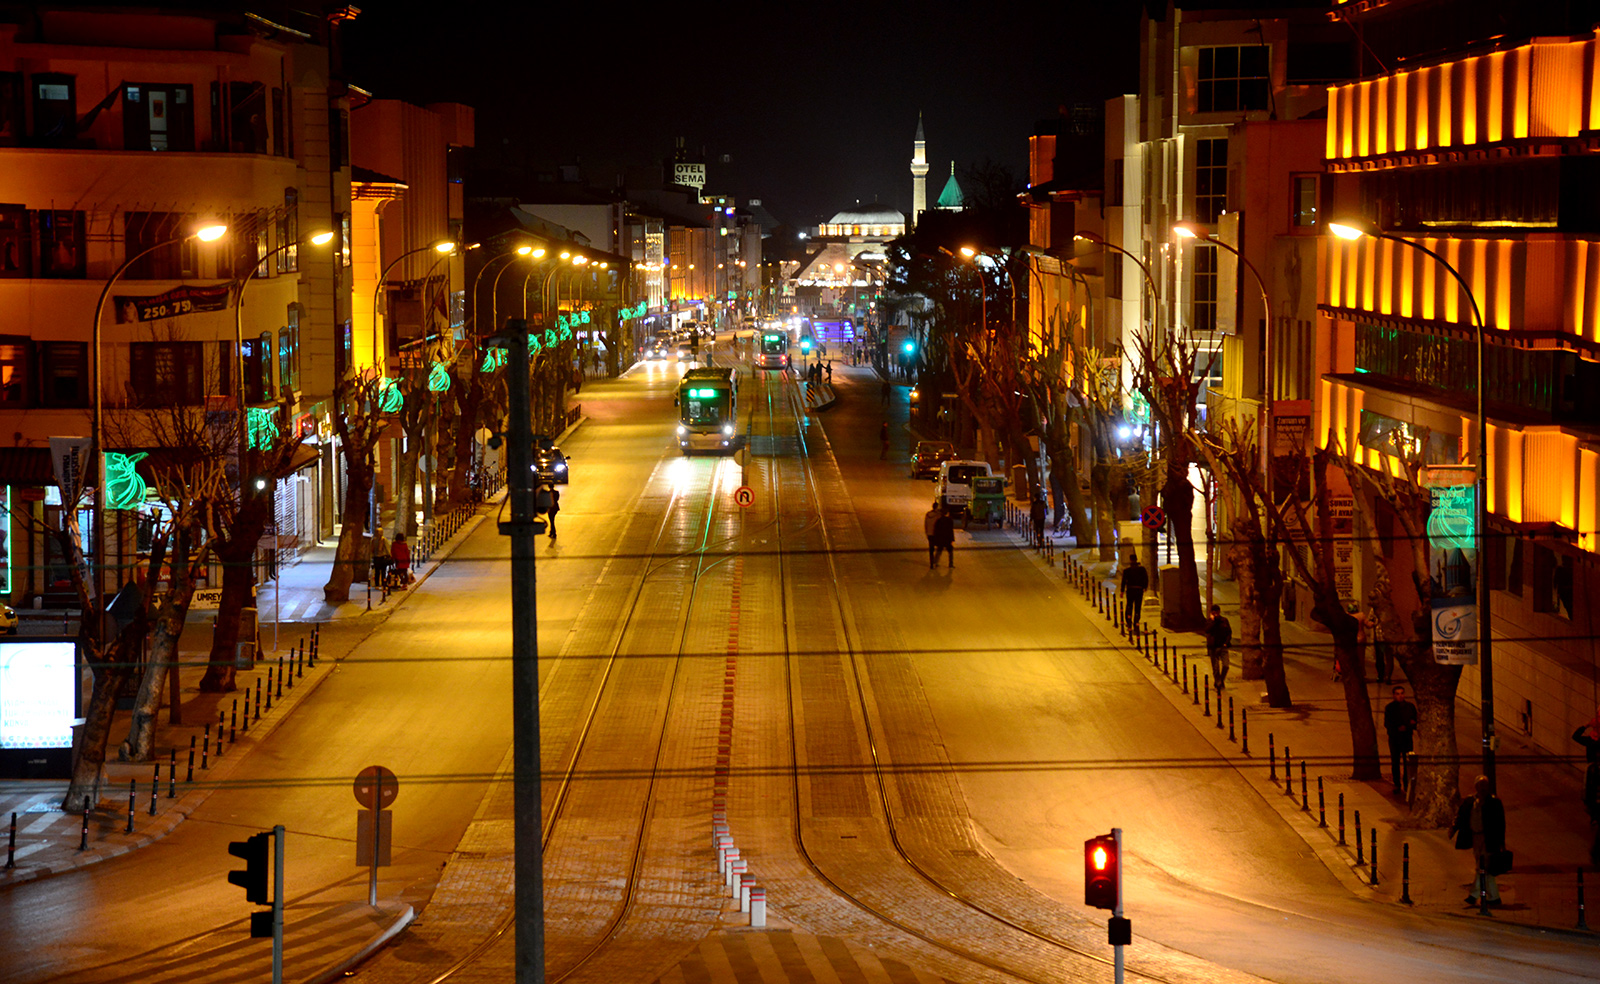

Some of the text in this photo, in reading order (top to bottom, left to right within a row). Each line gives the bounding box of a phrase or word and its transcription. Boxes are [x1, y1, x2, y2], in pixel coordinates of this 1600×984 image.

[676, 164, 703, 173] OTEL
[675, 174, 704, 182] SEMA
[143, 305, 167, 319] 250
